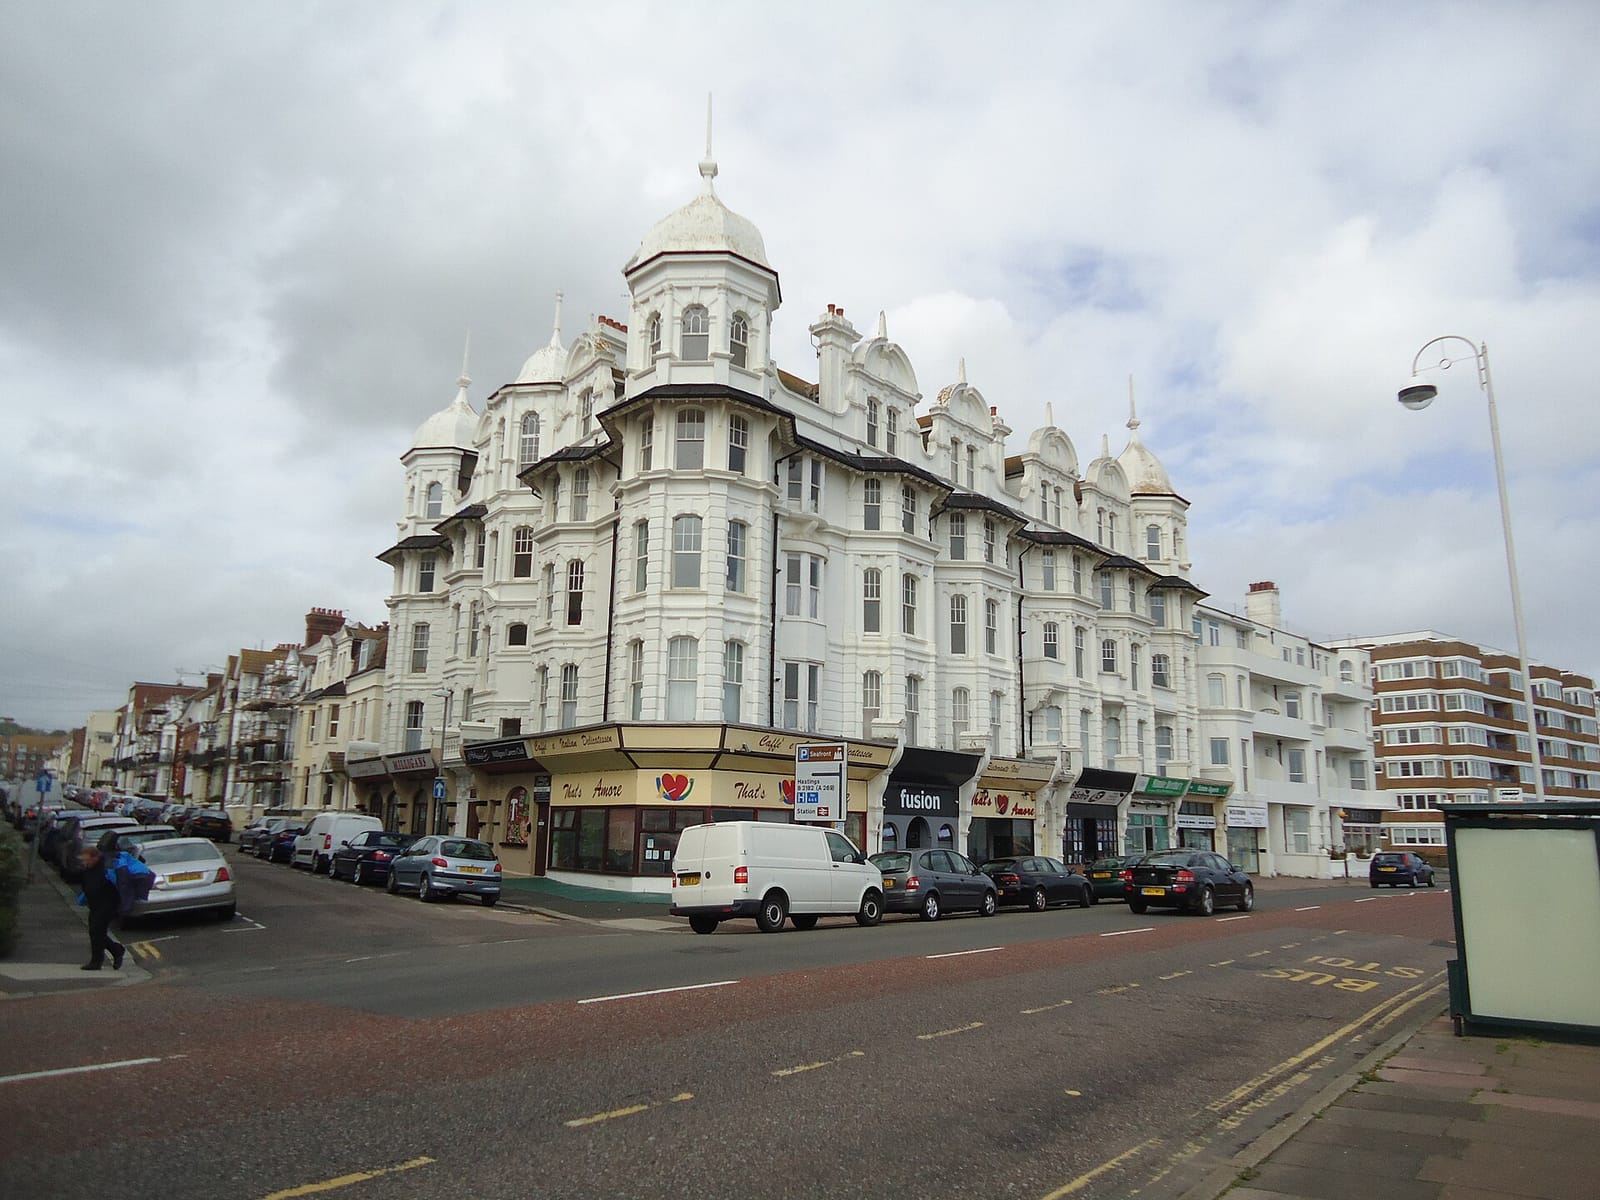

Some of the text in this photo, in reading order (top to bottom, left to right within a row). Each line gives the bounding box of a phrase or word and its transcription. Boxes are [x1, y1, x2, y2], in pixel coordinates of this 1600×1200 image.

[847, 749, 873, 759] catessen
[392, 756, 427, 771] MILLIGANS
[563, 783, 582, 799] That's
[592, 777, 624, 799] Amore
[734, 781, 766, 800] That's
[900, 788, 941, 810] fusion
[1011, 801, 1036, 816] Amore
